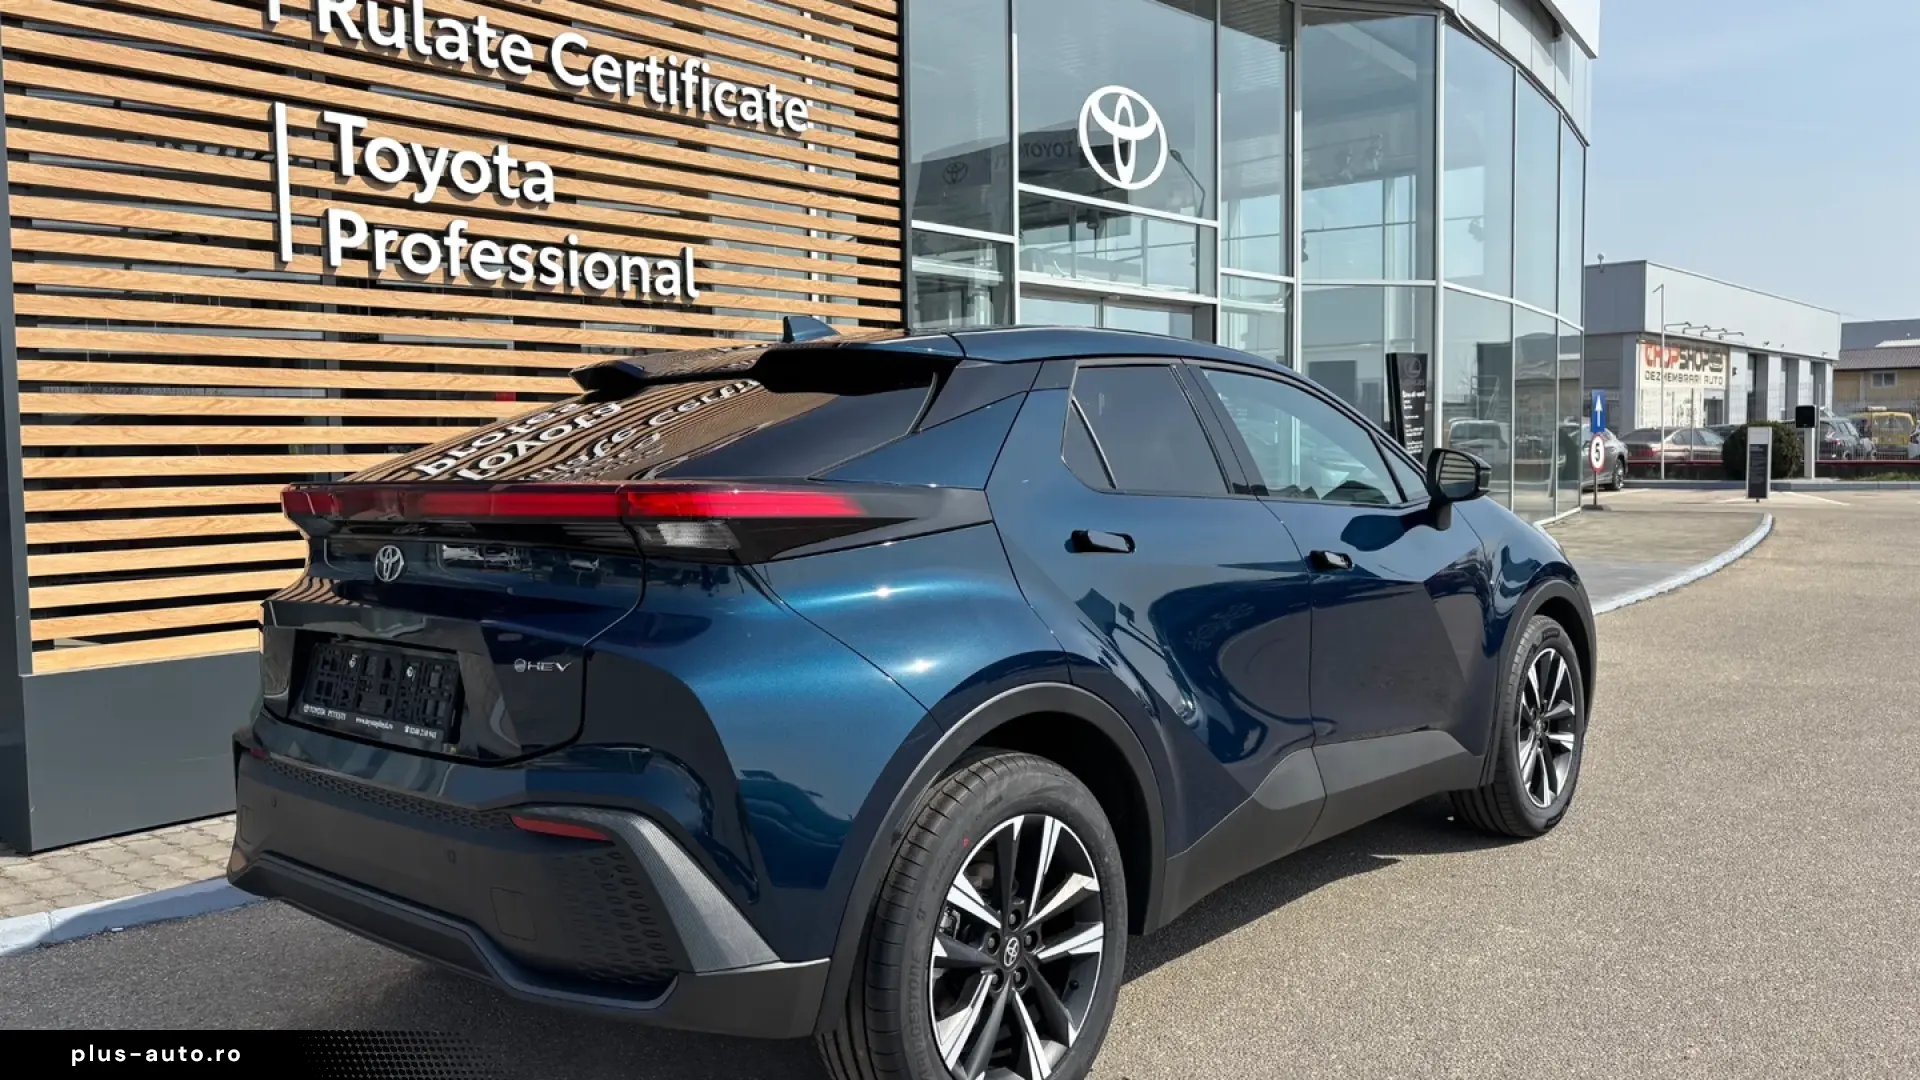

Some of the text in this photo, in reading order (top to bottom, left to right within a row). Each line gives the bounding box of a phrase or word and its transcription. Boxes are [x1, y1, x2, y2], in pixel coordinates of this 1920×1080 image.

[550, 32, 810, 132] Certificate
[322, 110, 555, 204] Toyota
[324, 207, 700, 299] Professional
[1595, 442, 1601, 461] 5
[527, 660, 572, 672] HEV
